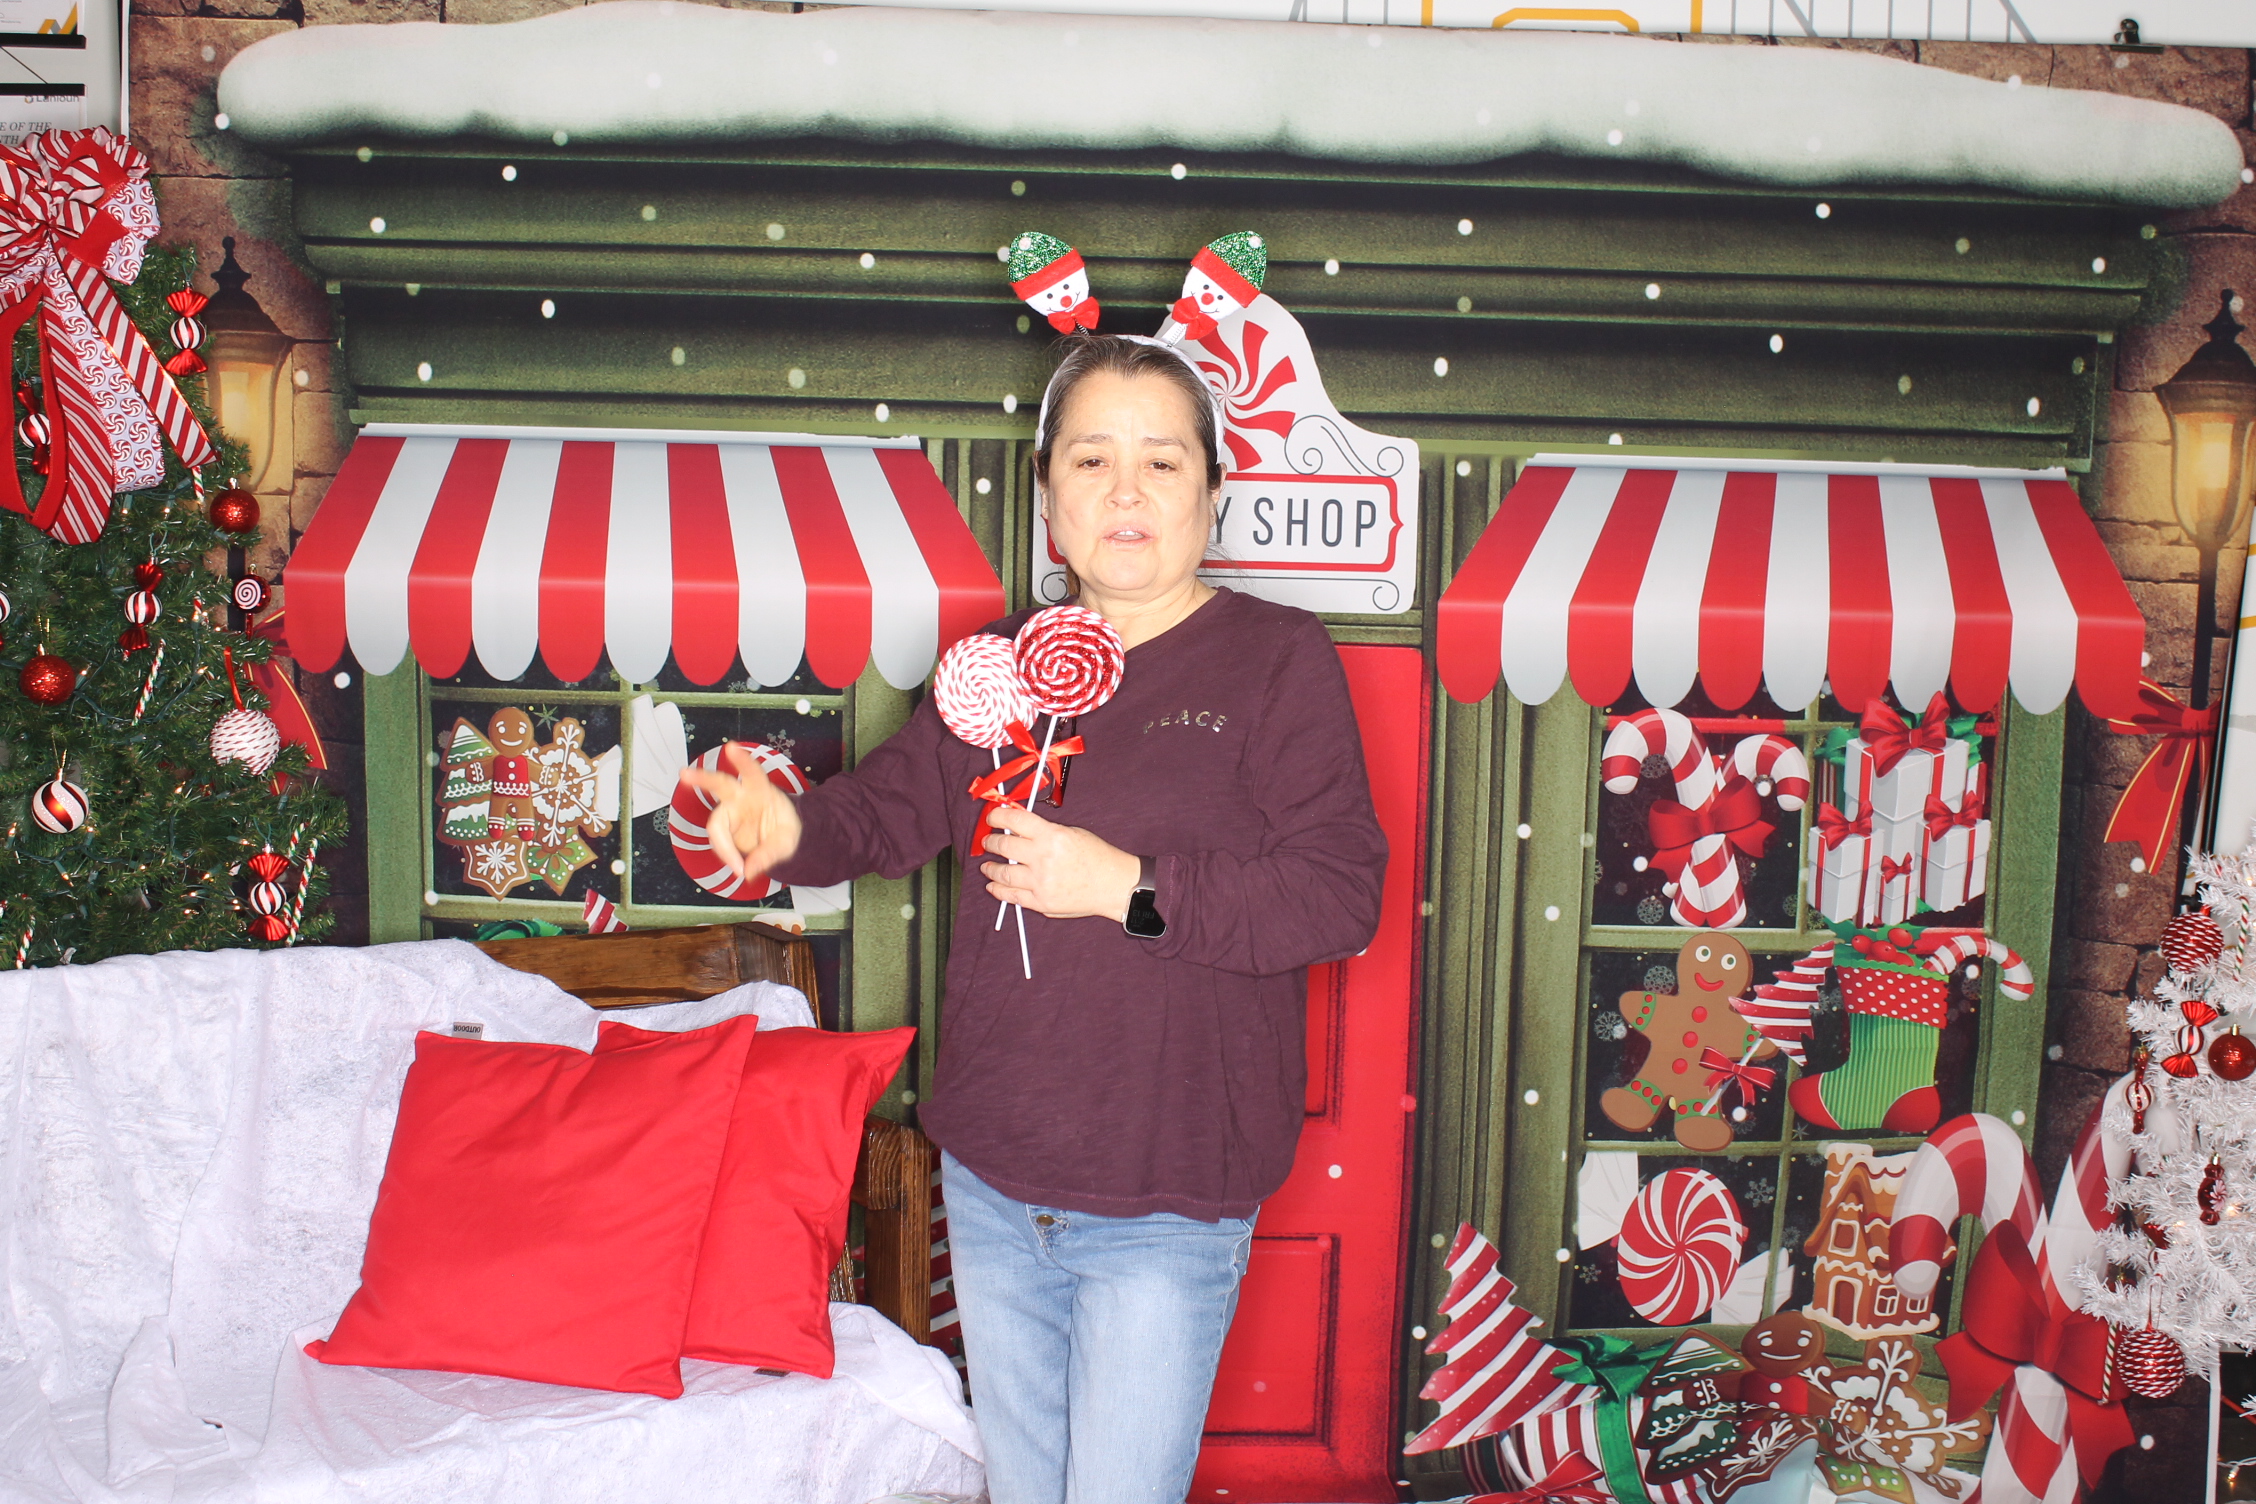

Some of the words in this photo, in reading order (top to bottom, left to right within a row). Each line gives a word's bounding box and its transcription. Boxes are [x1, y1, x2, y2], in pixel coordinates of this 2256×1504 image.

[9, 122, 26, 131] OF
[29, 122, 52, 131] THE
[0, 135, 19, 144] TH
[1253, 497, 1377, 547] SHOP
[453, 1025, 481, 1033] OUTDOOR
